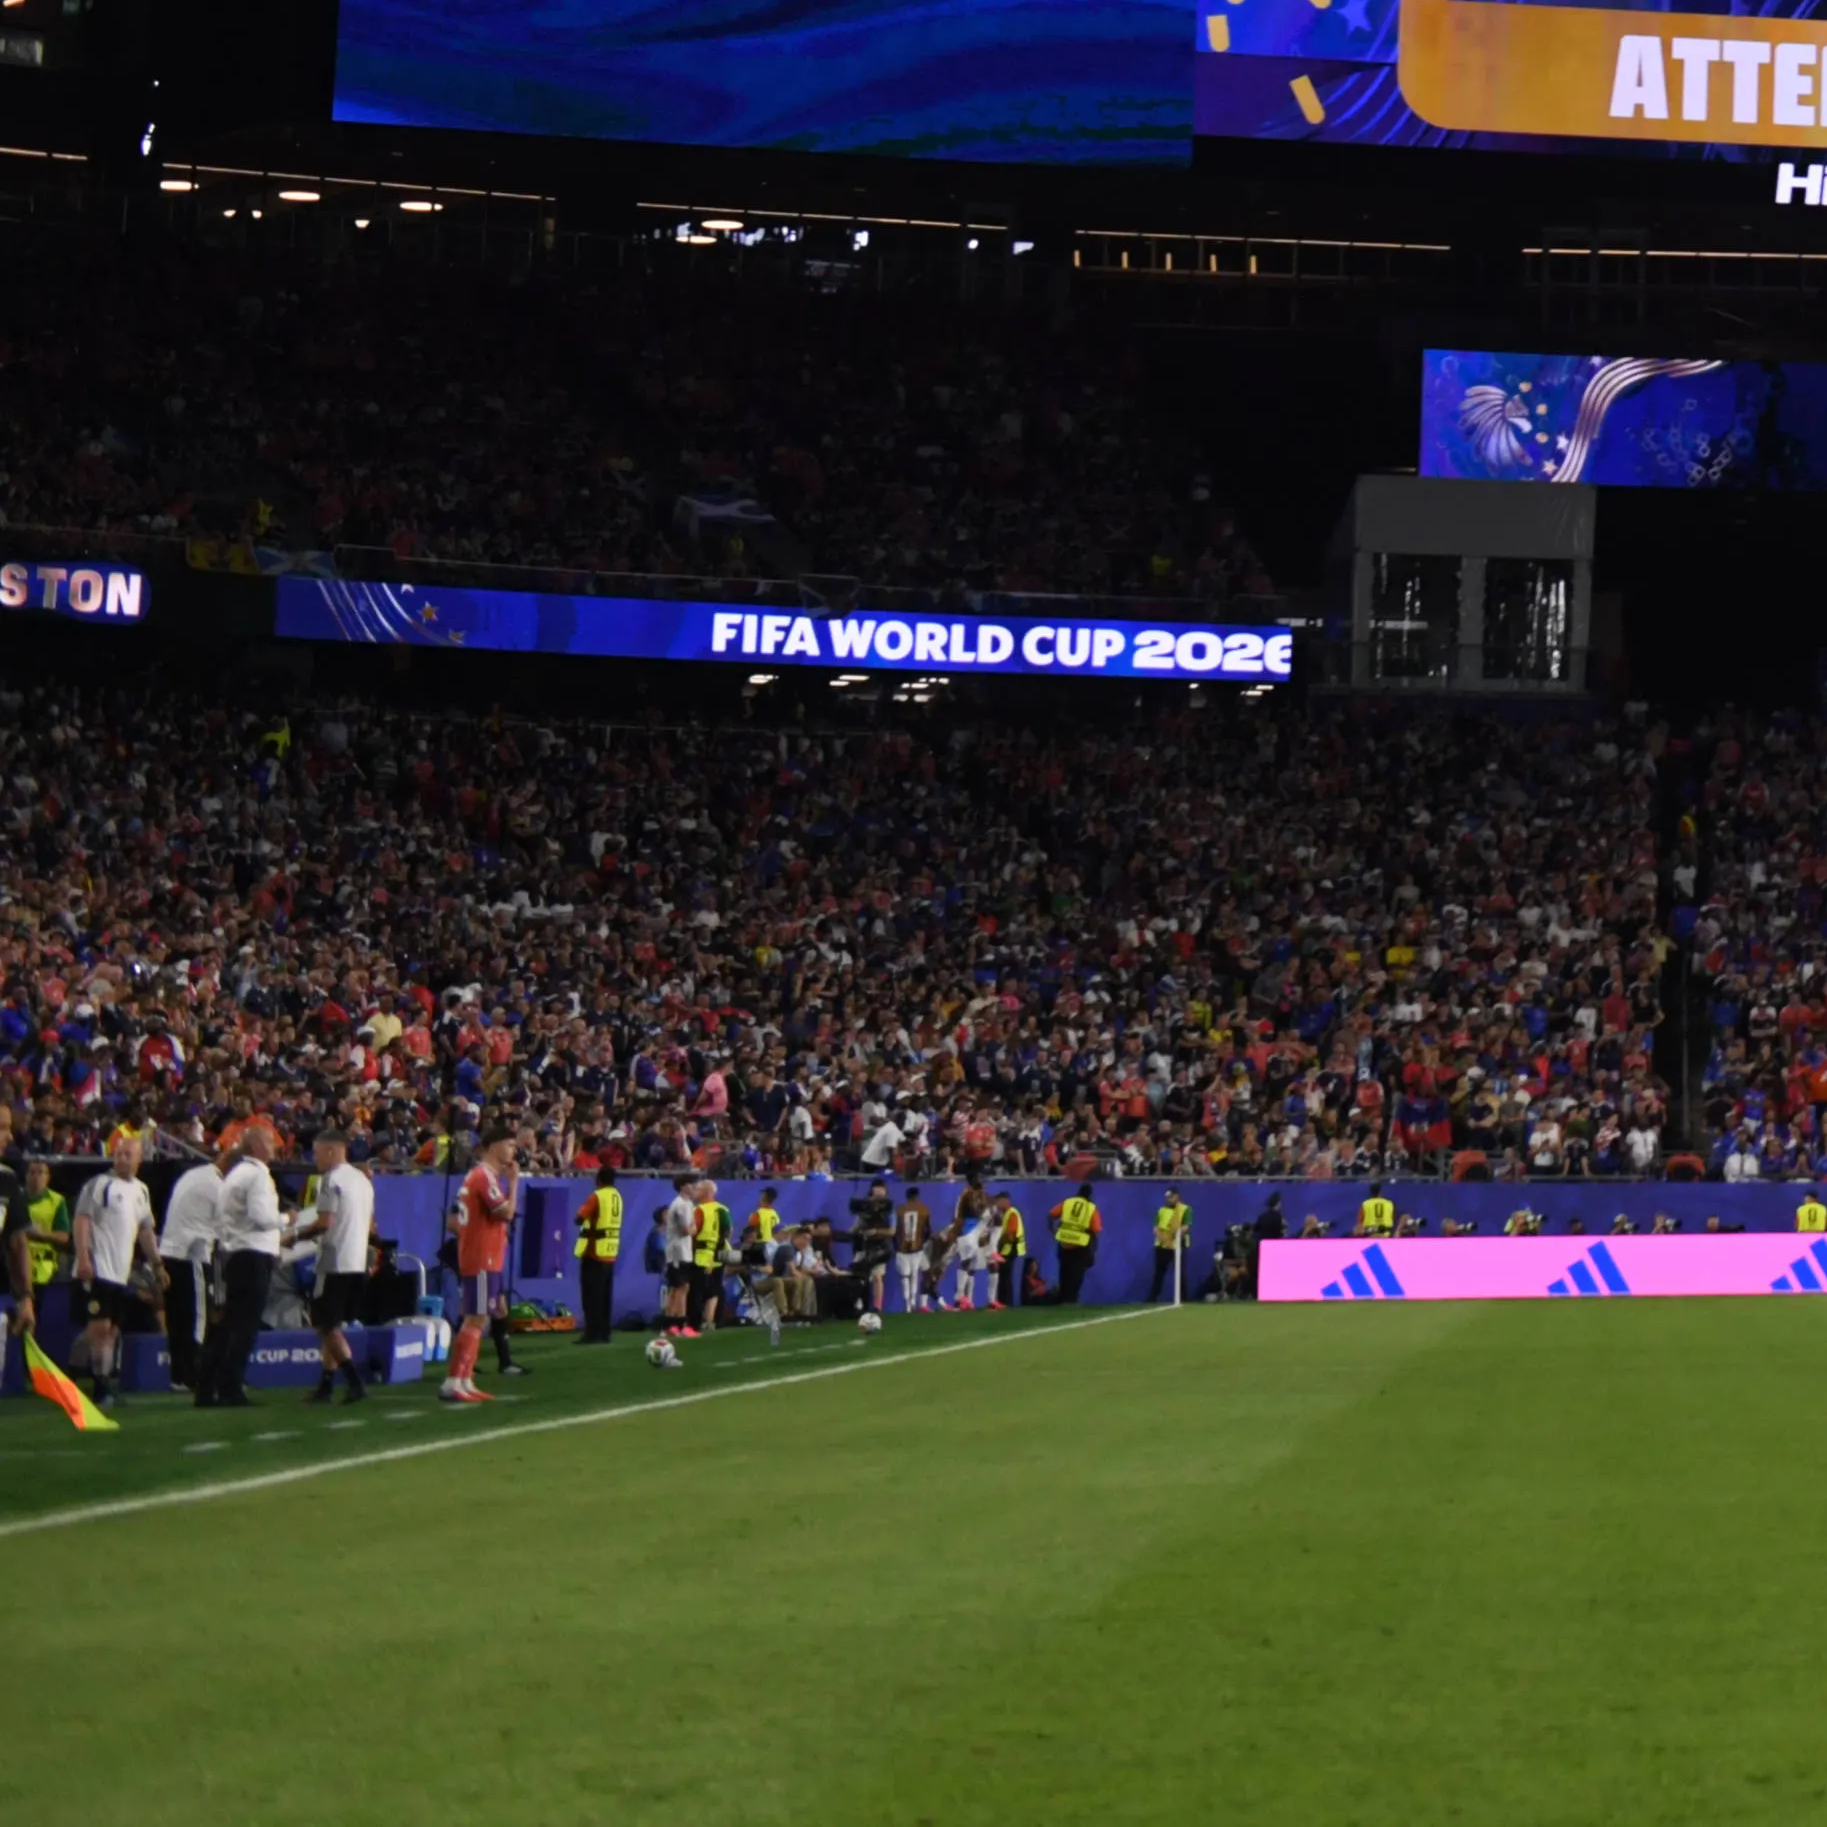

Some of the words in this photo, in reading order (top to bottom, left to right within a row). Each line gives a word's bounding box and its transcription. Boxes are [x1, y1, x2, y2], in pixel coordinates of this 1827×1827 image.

[712, 613, 820, 656] FIFA
[828, 619, 1014, 663] WORLD
[1022, 626, 1125, 667] CUP
